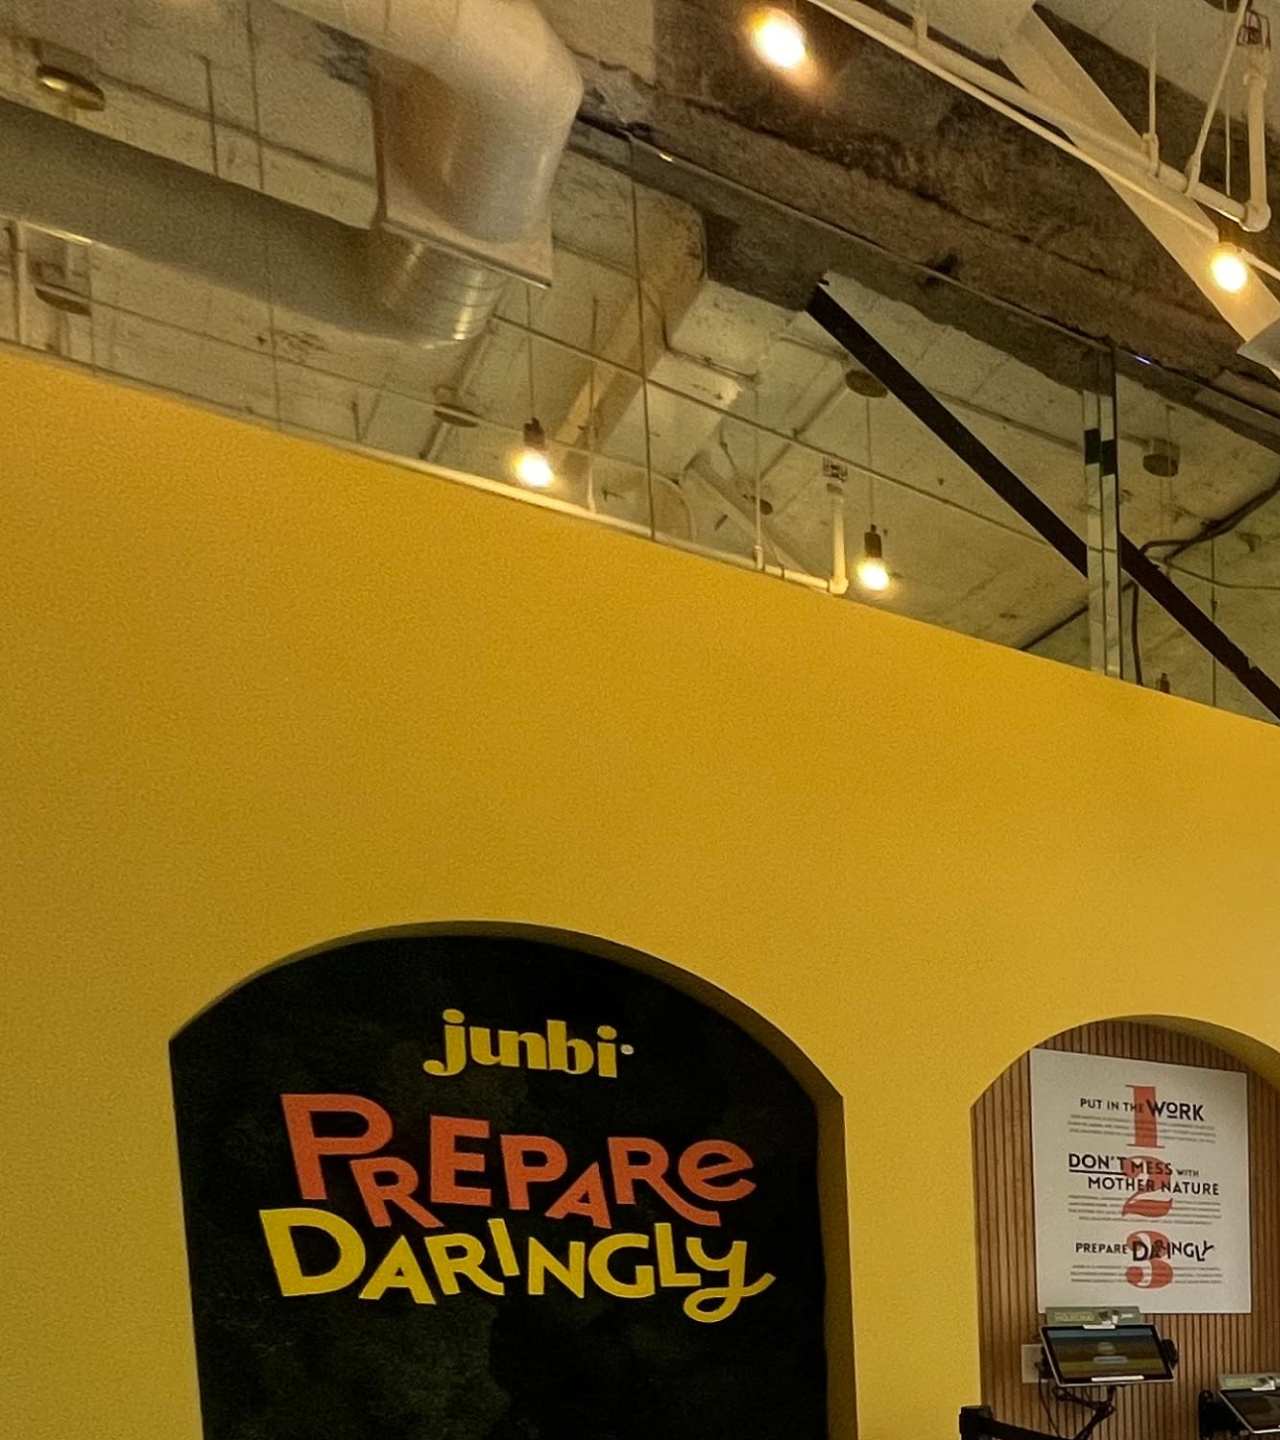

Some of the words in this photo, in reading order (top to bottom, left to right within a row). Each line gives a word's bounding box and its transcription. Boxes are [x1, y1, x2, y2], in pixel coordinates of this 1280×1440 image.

[1080, 1098, 1102, 1110] PUT
[1107, 1100, 1120, 1111] IN
[1124, 1102, 1145, 1114] THE
[1146, 1099, 1205, 1122] WORK
[1068, 1153, 1126, 1171] DON'T
[1131, 1160, 1173, 1175] MESS
[1176, 1168, 1199, 1177] WITH
[1088, 1177, 1154, 1193] MOTHER
[1161, 1180, 1220, 1196] NATURE
[1075, 1242, 1128, 1255] PREPARE
[1132, 1240, 1215, 1262] DARINGLY
